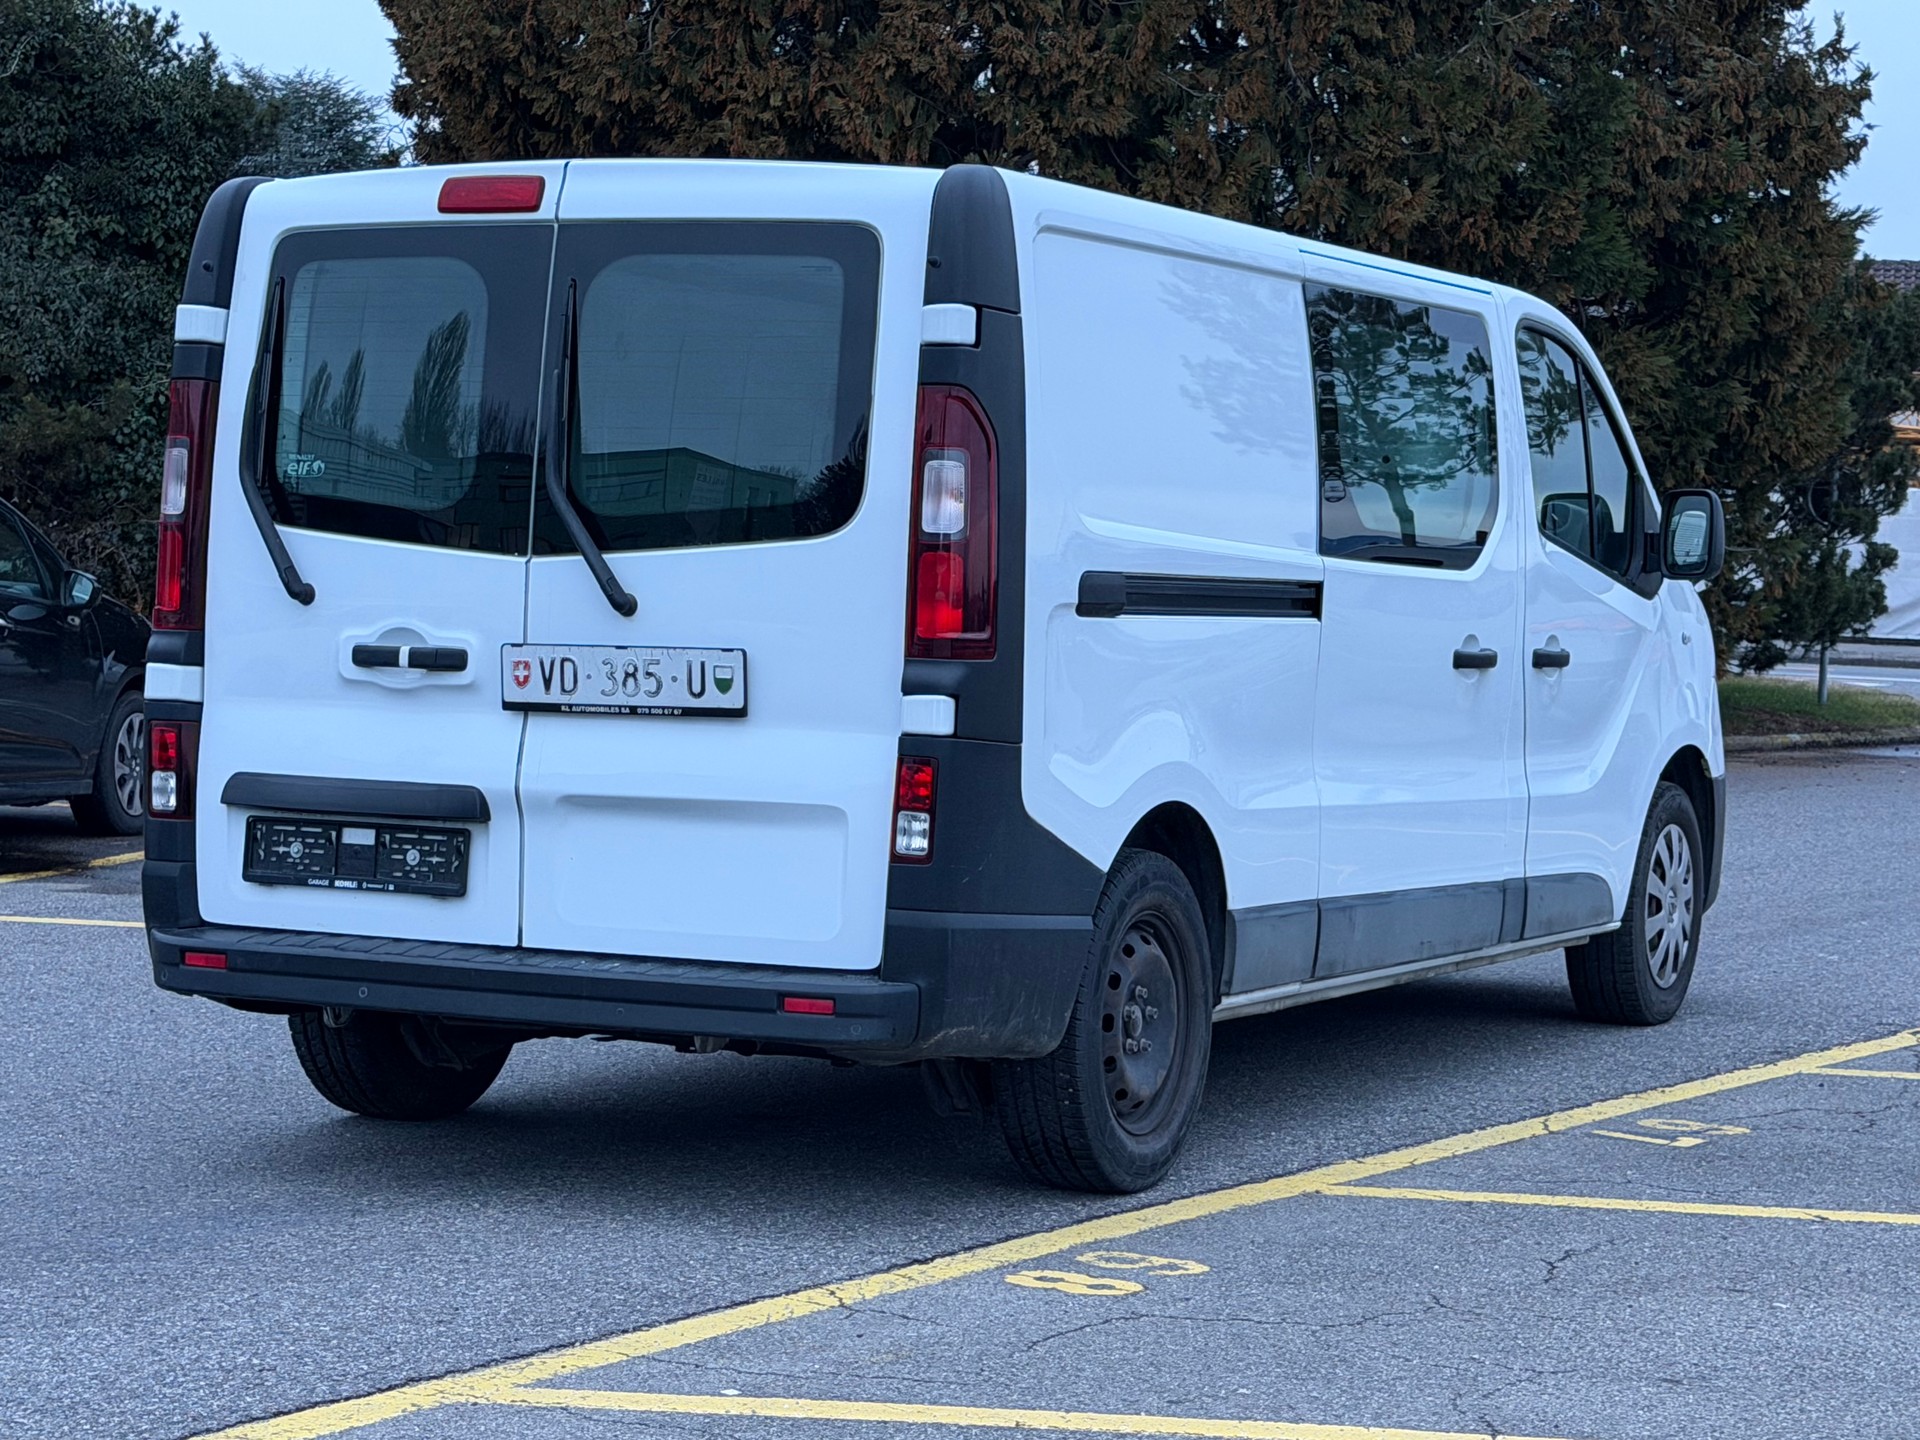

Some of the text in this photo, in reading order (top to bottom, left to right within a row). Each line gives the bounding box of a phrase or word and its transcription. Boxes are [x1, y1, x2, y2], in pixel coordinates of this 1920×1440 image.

[287, 461, 312, 475] elf
[572, 705, 620, 713] AUTOMOBILES
[621, 706, 631, 714] SA
[307, 878, 330, 886] GARAGE
